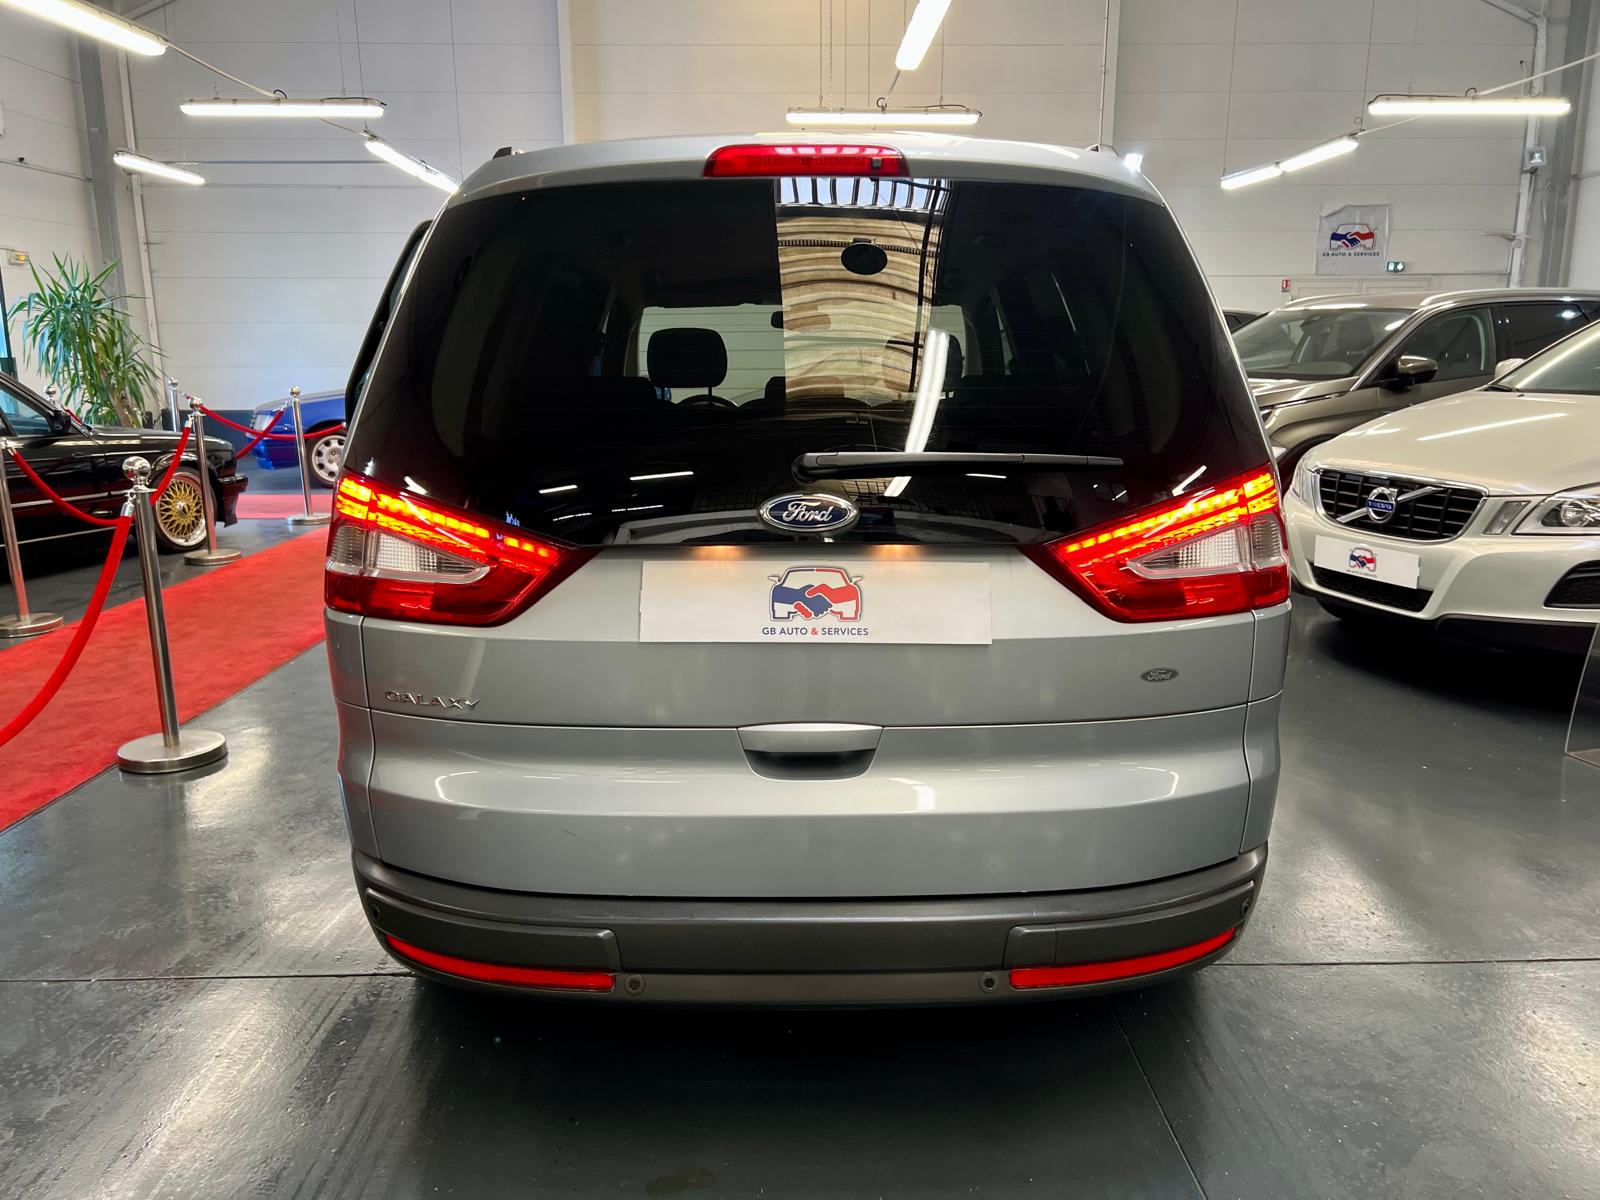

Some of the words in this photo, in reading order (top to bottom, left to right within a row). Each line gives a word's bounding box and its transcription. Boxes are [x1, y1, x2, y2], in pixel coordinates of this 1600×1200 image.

[1367, 500, 1392, 510] VOLVO
[782, 501, 834, 522] Ford
[761, 627, 776, 636] GB
[779, 627, 808, 636] AUTO
[810, 627, 819, 636] &
[821, 627, 869, 636] SERVICES
[1147, 670, 1173, 681] Ford
[384, 690, 480, 710] GALAXY
